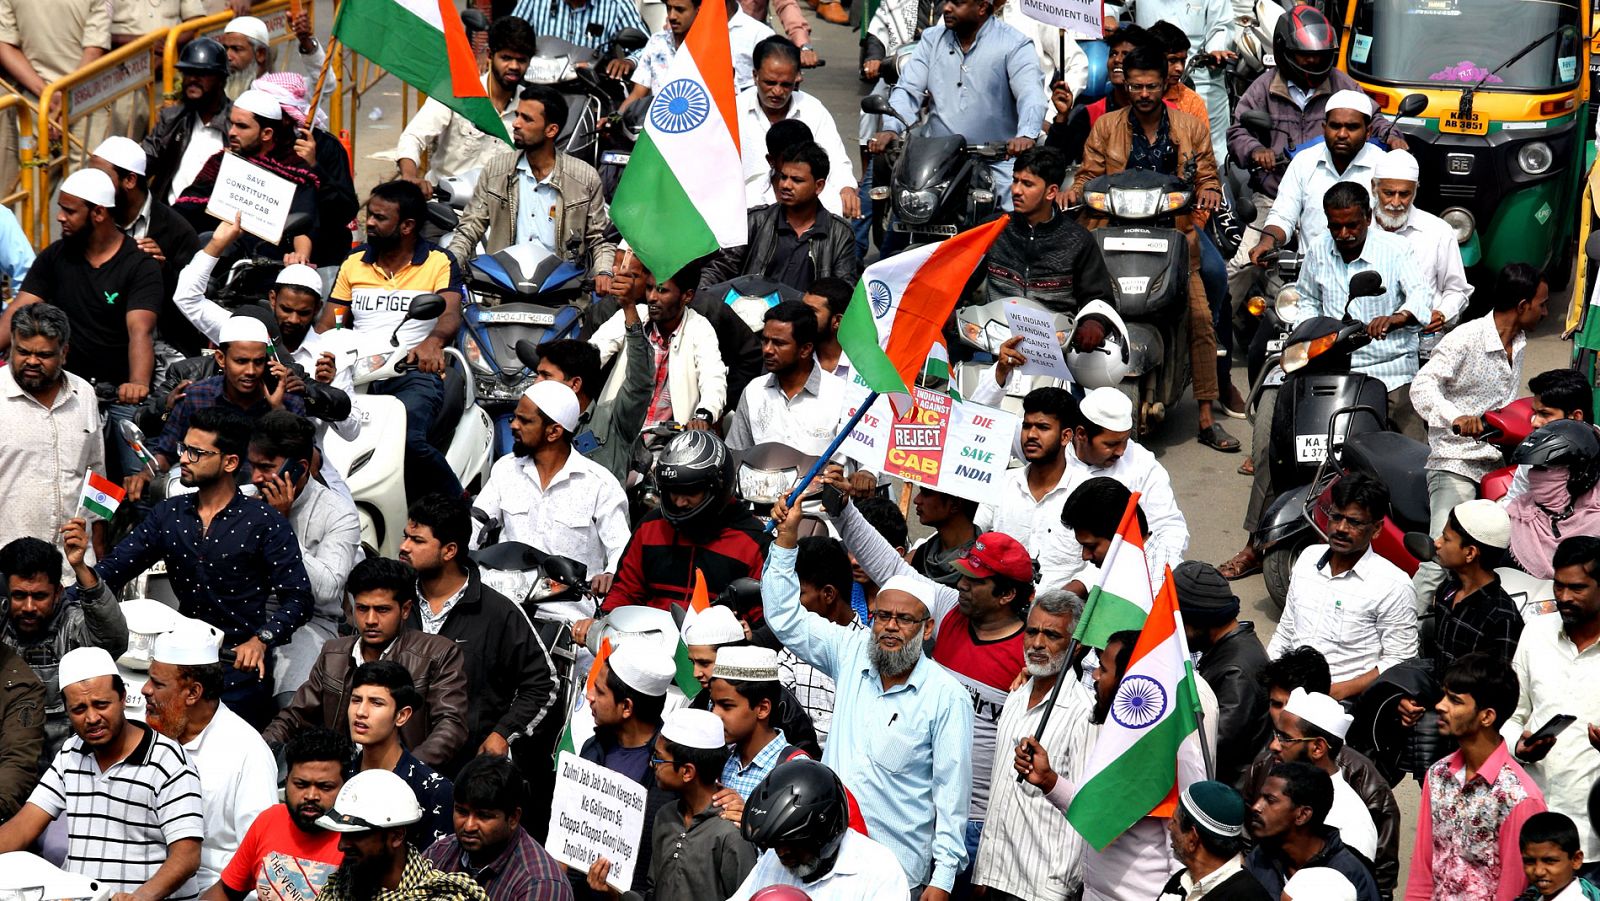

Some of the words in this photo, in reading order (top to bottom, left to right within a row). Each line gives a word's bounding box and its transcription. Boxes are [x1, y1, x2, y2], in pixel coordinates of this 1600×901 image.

[1024, 0, 1082, 20] AMENDMENT
[1083, 14, 1100, 26] BILL
[1445, 120, 1458, 128] AB
[1459, 121, 1483, 130] 3851
[1451, 160, 1469, 170] RE
[246, 174, 266, 187] SAVE
[225, 178, 280, 206] CONSTITUTION
[229, 192, 254, 206] SCRAP
[254, 203, 270, 215] CAB
[354, 293, 414, 313] HILFIGE
[1010, 312, 1022, 322] WE
[1022, 315, 1051, 328] INDIANS
[1016, 324, 1050, 339] STANDING
[1022, 336, 1050, 349] AGAINST
[1021, 347, 1036, 356] NRC
[1042, 352, 1058, 361] CAB
[1031, 358, 1055, 368] REJECT
[916, 388, 945, 405] INDIANS
[919, 400, 951, 414] AGAINST
[847, 407, 880, 428] SVE
[939, 418, 947, 427] &
[971, 414, 996, 430] DIE
[848, 429, 875, 448] NDIA
[895, 429, 941, 446] REJECT
[974, 434, 987, 444] TO
[1305, 438, 1320, 447] KA
[888, 448, 939, 475] CAB
[960, 445, 996, 464] SAVE
[898, 470, 923, 482] 2019
[954, 464, 993, 484] INDIA
[562, 761, 580, 781] Zulmi
[579, 768, 591, 787] Jab
[590, 773, 601, 791] Jab
[601, 777, 617, 798] Zulm
[615, 784, 633, 808] Karega
[631, 793, 644, 812] Satta
[581, 794, 590, 811] Ke
[559, 811, 580, 836] Chappa
[580, 820, 601, 845] Chappa
[601, 830, 618, 854] Goonj
[616, 837, 633, 861] Uthega
[563, 839, 587, 863] Inquilab
[270, 854, 285, 876] THE
